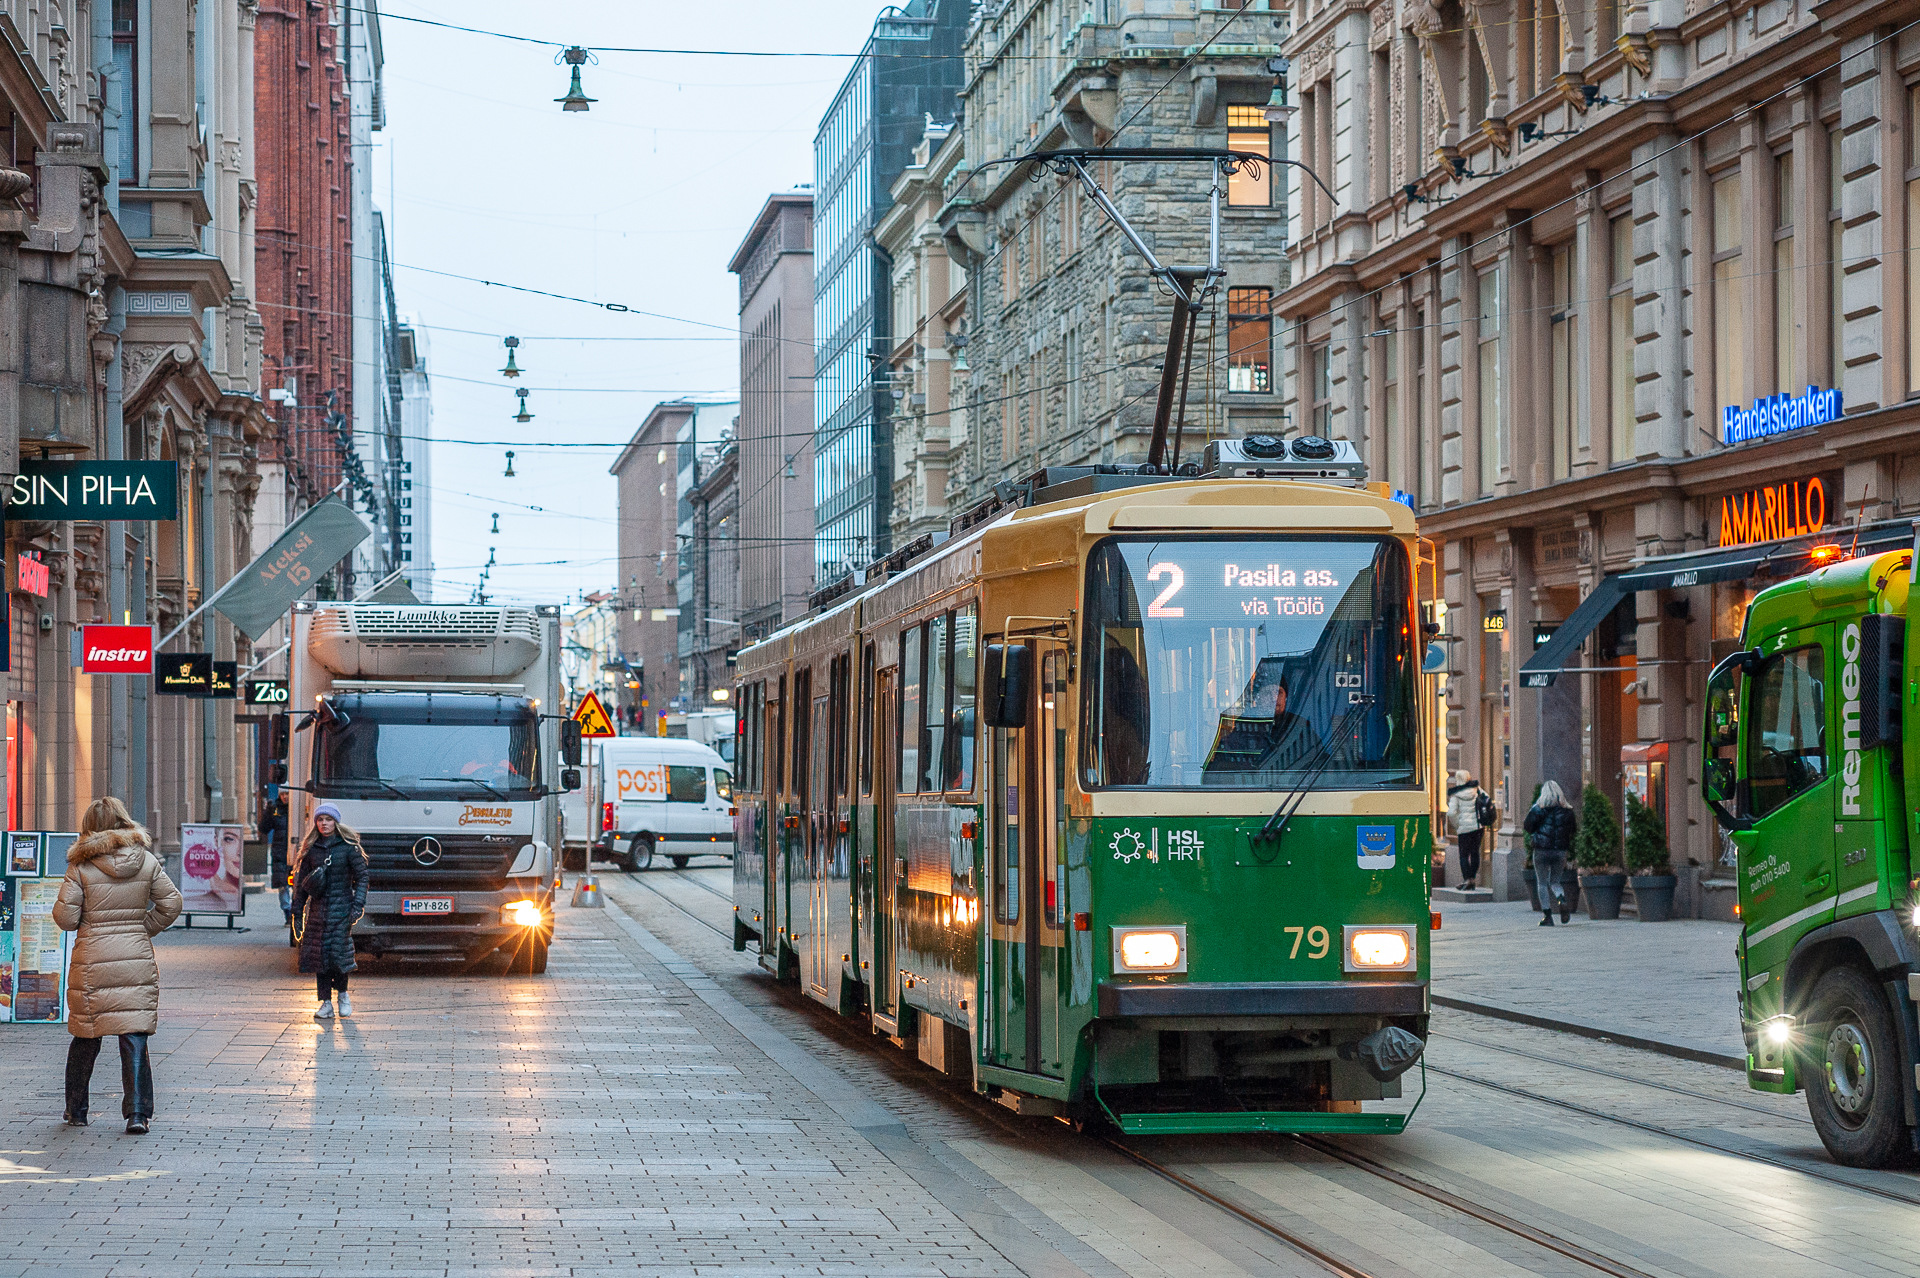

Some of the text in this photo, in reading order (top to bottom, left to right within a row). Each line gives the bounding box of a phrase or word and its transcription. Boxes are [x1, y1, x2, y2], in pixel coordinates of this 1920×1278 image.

[1723, 385, 1838, 444] Handelsbanken
[9, 474, 157, 506] SIN PIHA
[399, 462, 410, 561] KLUUVI
[1719, 477, 1825, 547] AMARILLO
[260, 531, 314, 586] Aleksi
[286, 561, 311, 587] 15
[1224, 563, 1339, 587] Pasila as.
[1671, 571, 1698, 587] AMARILLO
[1146, 561, 1185, 618] 2
[397, 610, 457, 622] Lumikko
[1240, 596, 1325, 616] via Töölö
[87, 646, 148, 662] instru
[254, 682, 288, 702] Zio
[1528, 674, 1548, 687] AMARILLO
[1842, 623, 1861, 816] Remeo
[617, 764, 671, 800] posti
[1167, 830, 1204, 845] HSL
[1168, 845, 1205, 861] HRT
[1748, 854, 1777, 877] Remeo Oy
[1750, 861, 1791, 894] puh 010 5400
[410, 901, 449, 910] MPY-826
[1283, 925, 1330, 960] 79
